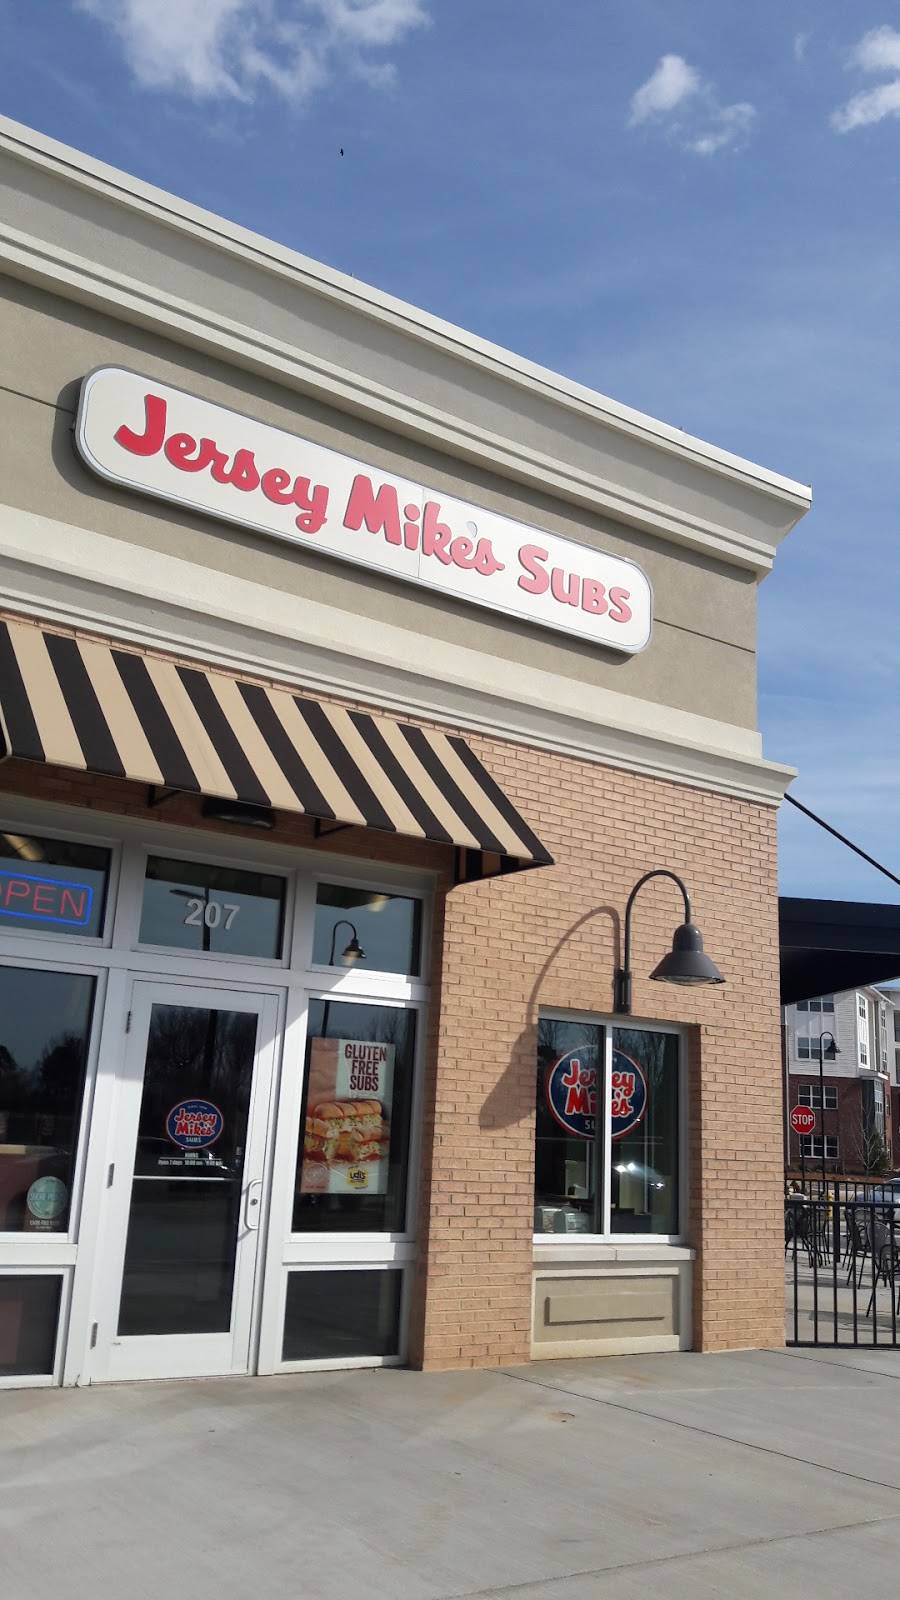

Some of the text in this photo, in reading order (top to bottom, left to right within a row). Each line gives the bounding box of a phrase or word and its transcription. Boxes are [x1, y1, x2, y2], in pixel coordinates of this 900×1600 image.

[113, 393, 329, 534] Jersey
[343, 474, 505, 576] Mike's
[0, 880, 87, 918] PEN
[184, 898, 241, 930] 207
[345, 1043, 387, 1061] GLUTEN
[351, 1060, 379, 1076] FREE
[350, 1075, 379, 1091] SUBS
[174, 1108, 217, 1126] Jersey
[792, 1113, 814, 1125] STOP
[175, 1120, 215, 1136] Mike's
